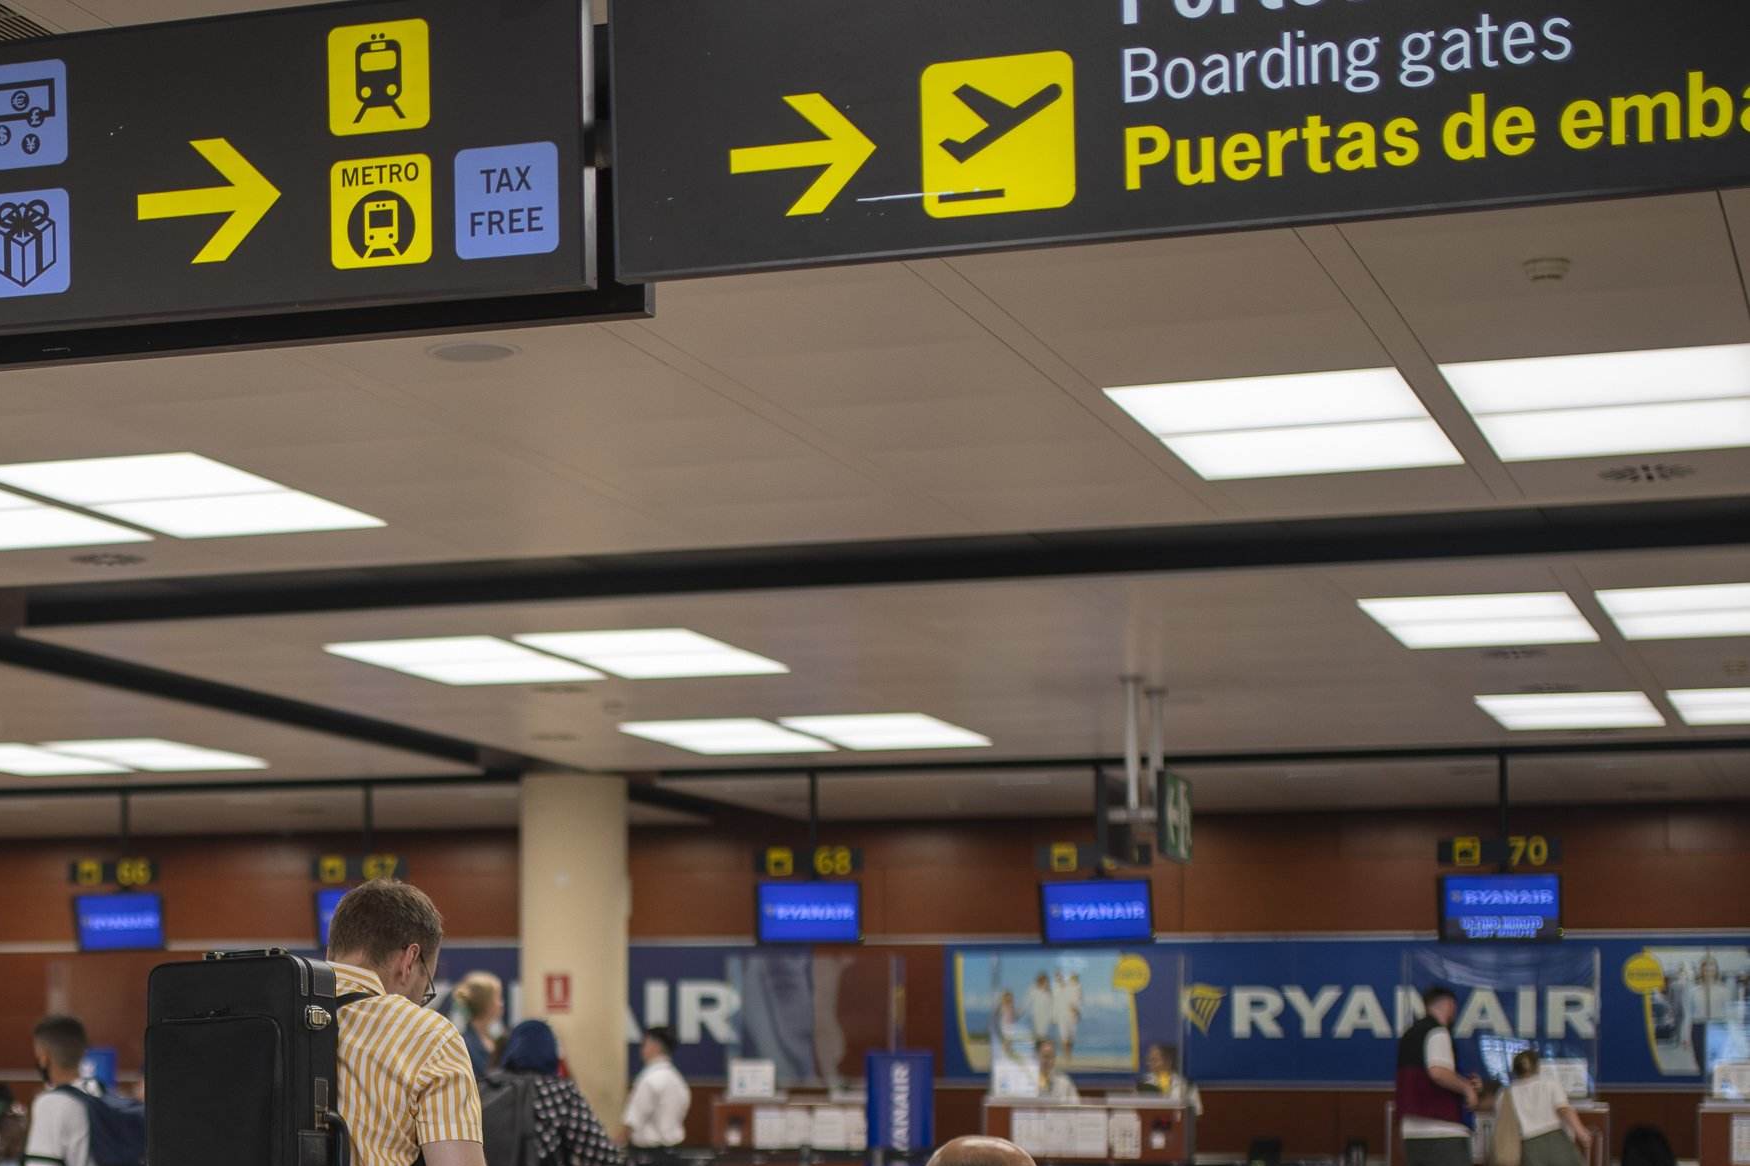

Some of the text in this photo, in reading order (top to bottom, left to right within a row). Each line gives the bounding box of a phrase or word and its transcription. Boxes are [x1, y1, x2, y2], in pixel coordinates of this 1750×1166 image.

[1122, 13, 1573, 103] Boarding gates
[1124, 71, 1750, 190] Puertas de emb
[341, 161, 419, 188] METRO
[480, 165, 532, 194] TAX
[470, 206, 544, 238] FREE
[813, 846, 852, 876] 68
[1508, 836, 1549, 866] 70
[1463, 888, 1554, 905] RYANAIR
